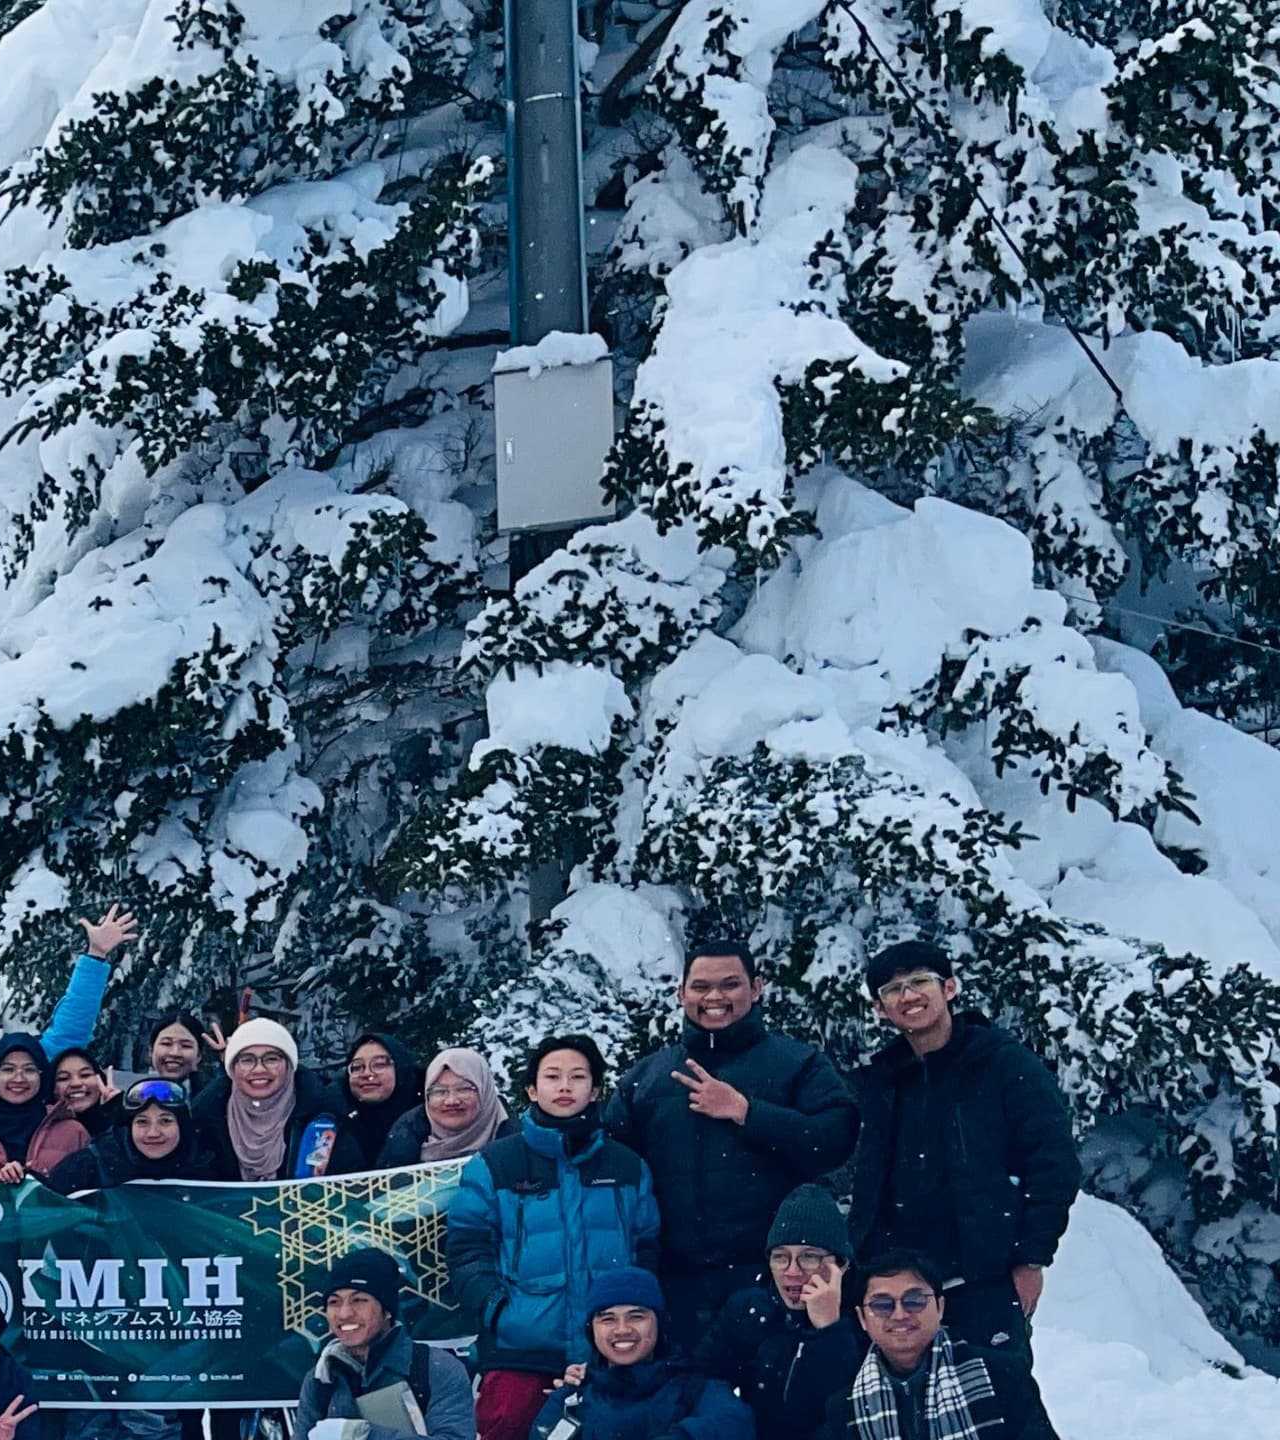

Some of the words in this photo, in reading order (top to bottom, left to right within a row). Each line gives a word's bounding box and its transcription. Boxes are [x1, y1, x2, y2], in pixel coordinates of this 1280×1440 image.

[17, 1256, 244, 1308] KMIH
[23, 1309, 243, 1327] インドネシアムスリム協会
[50, 1330, 94, 1341] MUSLIM
[98, 1329, 166, 1340] INDONESIA
[170, 1328, 242, 1340] HIROSHIMA
